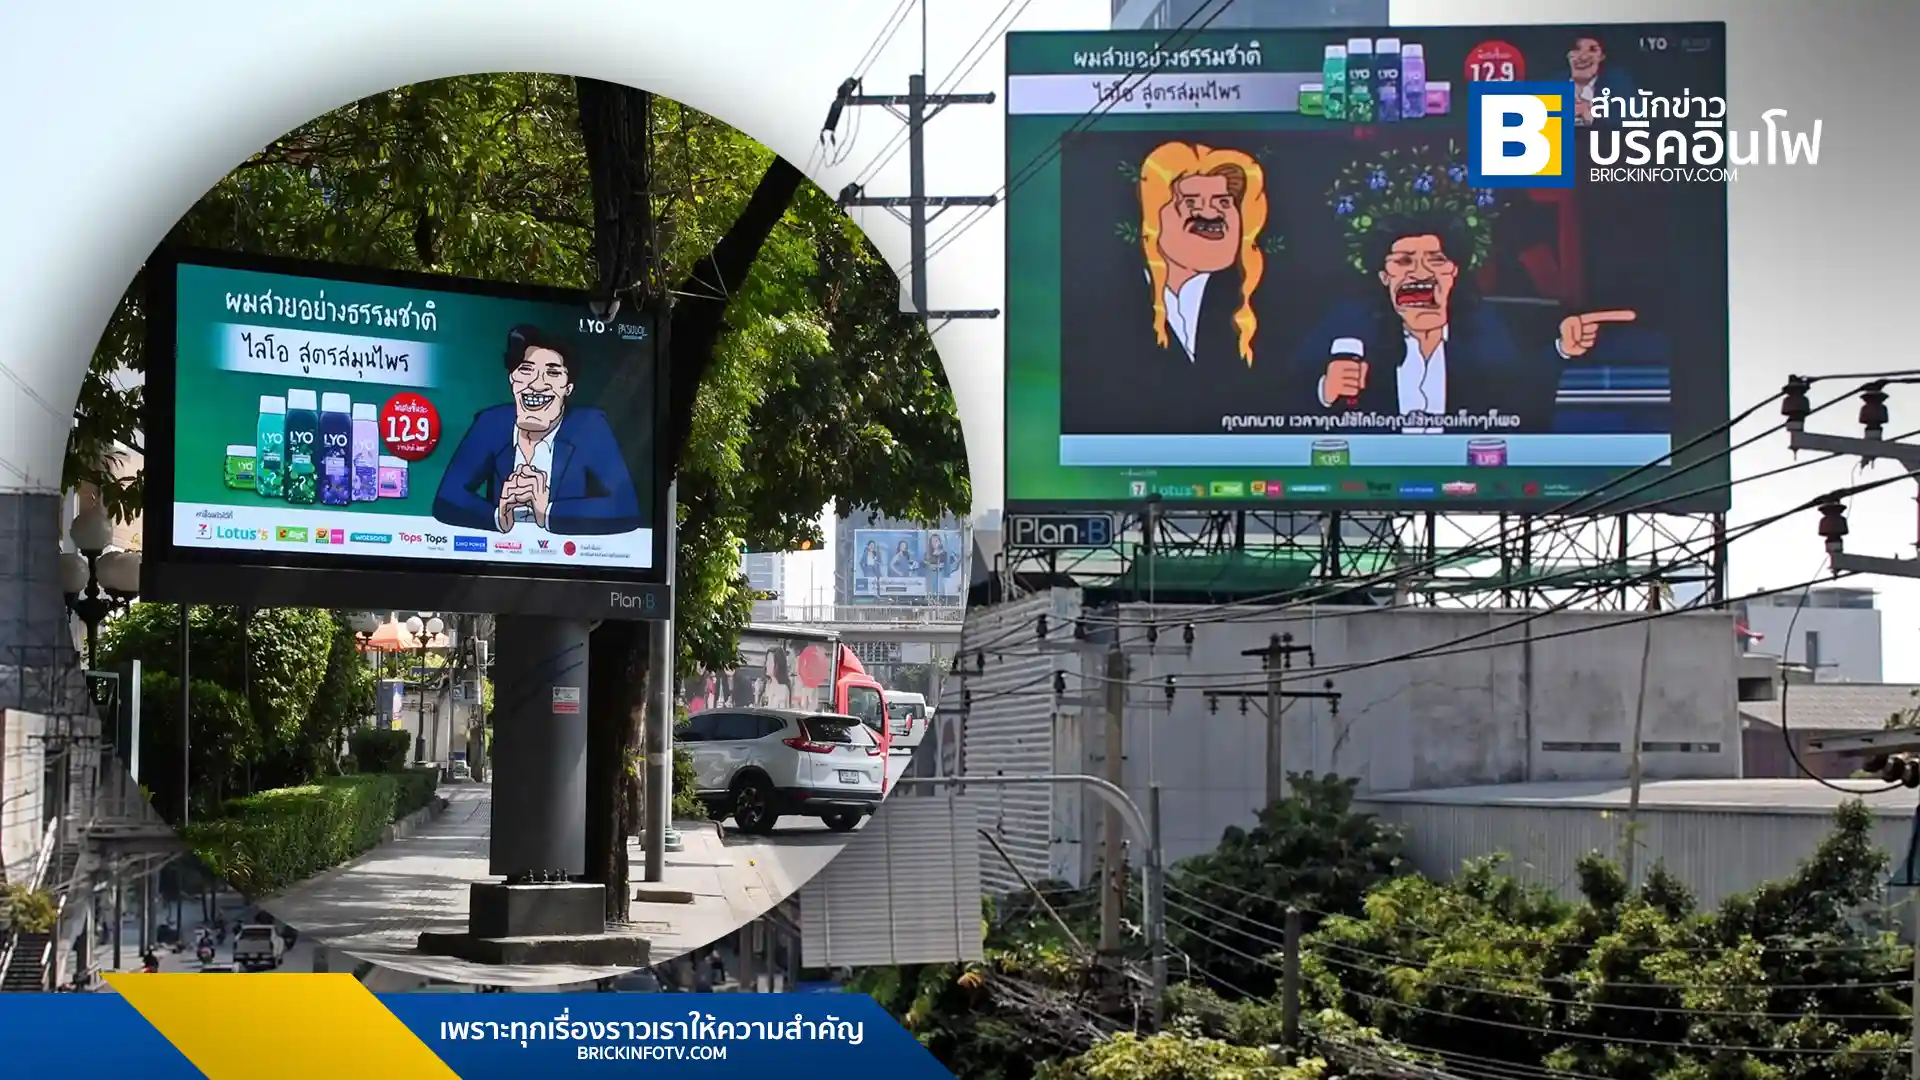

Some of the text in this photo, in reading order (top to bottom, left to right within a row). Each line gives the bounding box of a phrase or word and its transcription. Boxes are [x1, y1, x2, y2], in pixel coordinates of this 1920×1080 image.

[1073, 40, 1262, 69] ผมสวยอย่างธรรมชาติ
[1141, 80, 1241, 109] สูตรสมุนไพร
[225, 288, 437, 332] ผมสวยอย่างธรรมชาติ
[241, 332, 410, 379] ไลโอ สูตรสมุนไพร
[290, 431, 314, 444] LYO
[324, 433, 348, 447] LYO
[216, 526, 268, 541] Lotus's
[355, 534, 387, 542] watsons
[399, 532, 448, 545] Tops Tops
[610, 591, 642, 608] Plan
